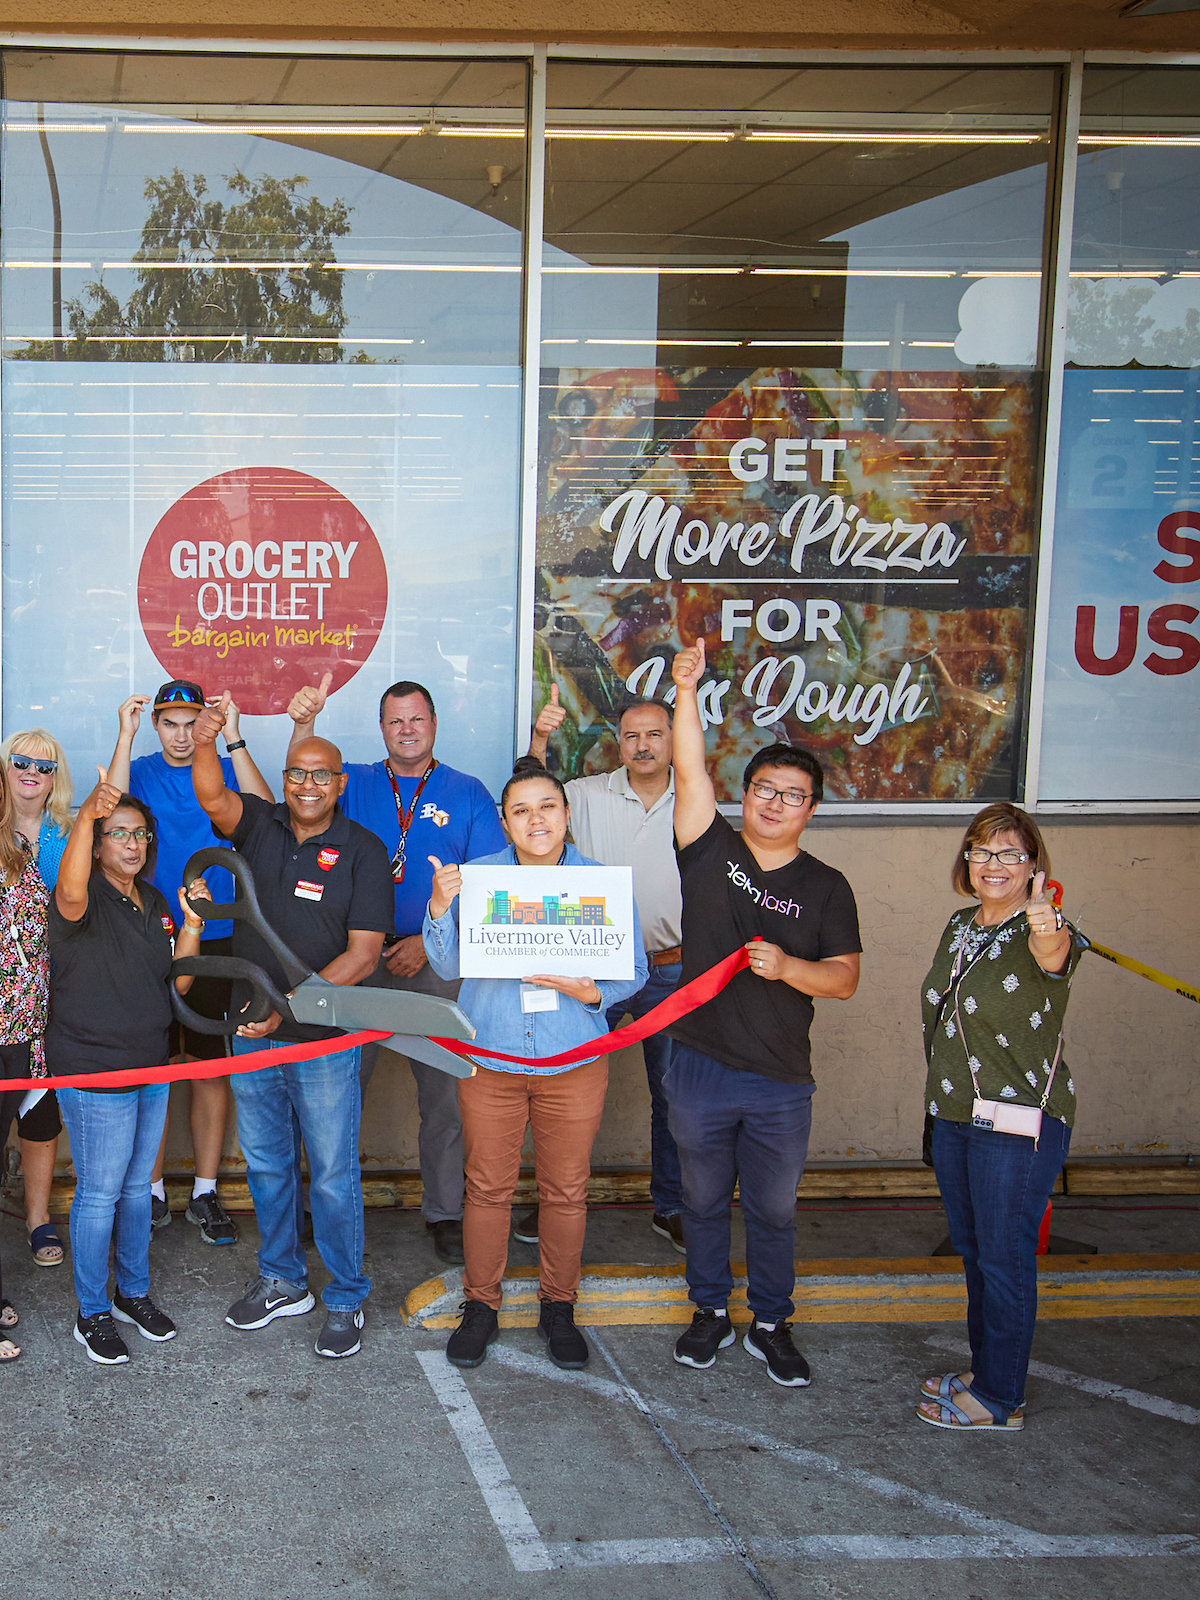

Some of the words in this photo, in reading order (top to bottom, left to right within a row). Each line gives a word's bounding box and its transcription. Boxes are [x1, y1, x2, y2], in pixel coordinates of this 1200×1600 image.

[729, 437, 847, 482] GET
[1092, 454, 1128, 497] 2
[599, 489, 777, 581] More
[778, 493, 967, 574] Pizza
[170, 540, 358, 579] GROCERY
[197, 582, 331, 620] OUTLET
[721, 598, 842, 642] FOR
[167, 614, 267, 658] bargain
[275, 622, 357, 647] market
[625, 655, 732, 731] Lss
[742, 654, 929, 746] Dough
[468, 927, 564, 945] Livermore
[568, 928, 626, 950] Valley
[485, 947, 537, 956] CHAMBER
[539, 947, 548, 957] of
[550, 948, 610, 957] COMMERCE
